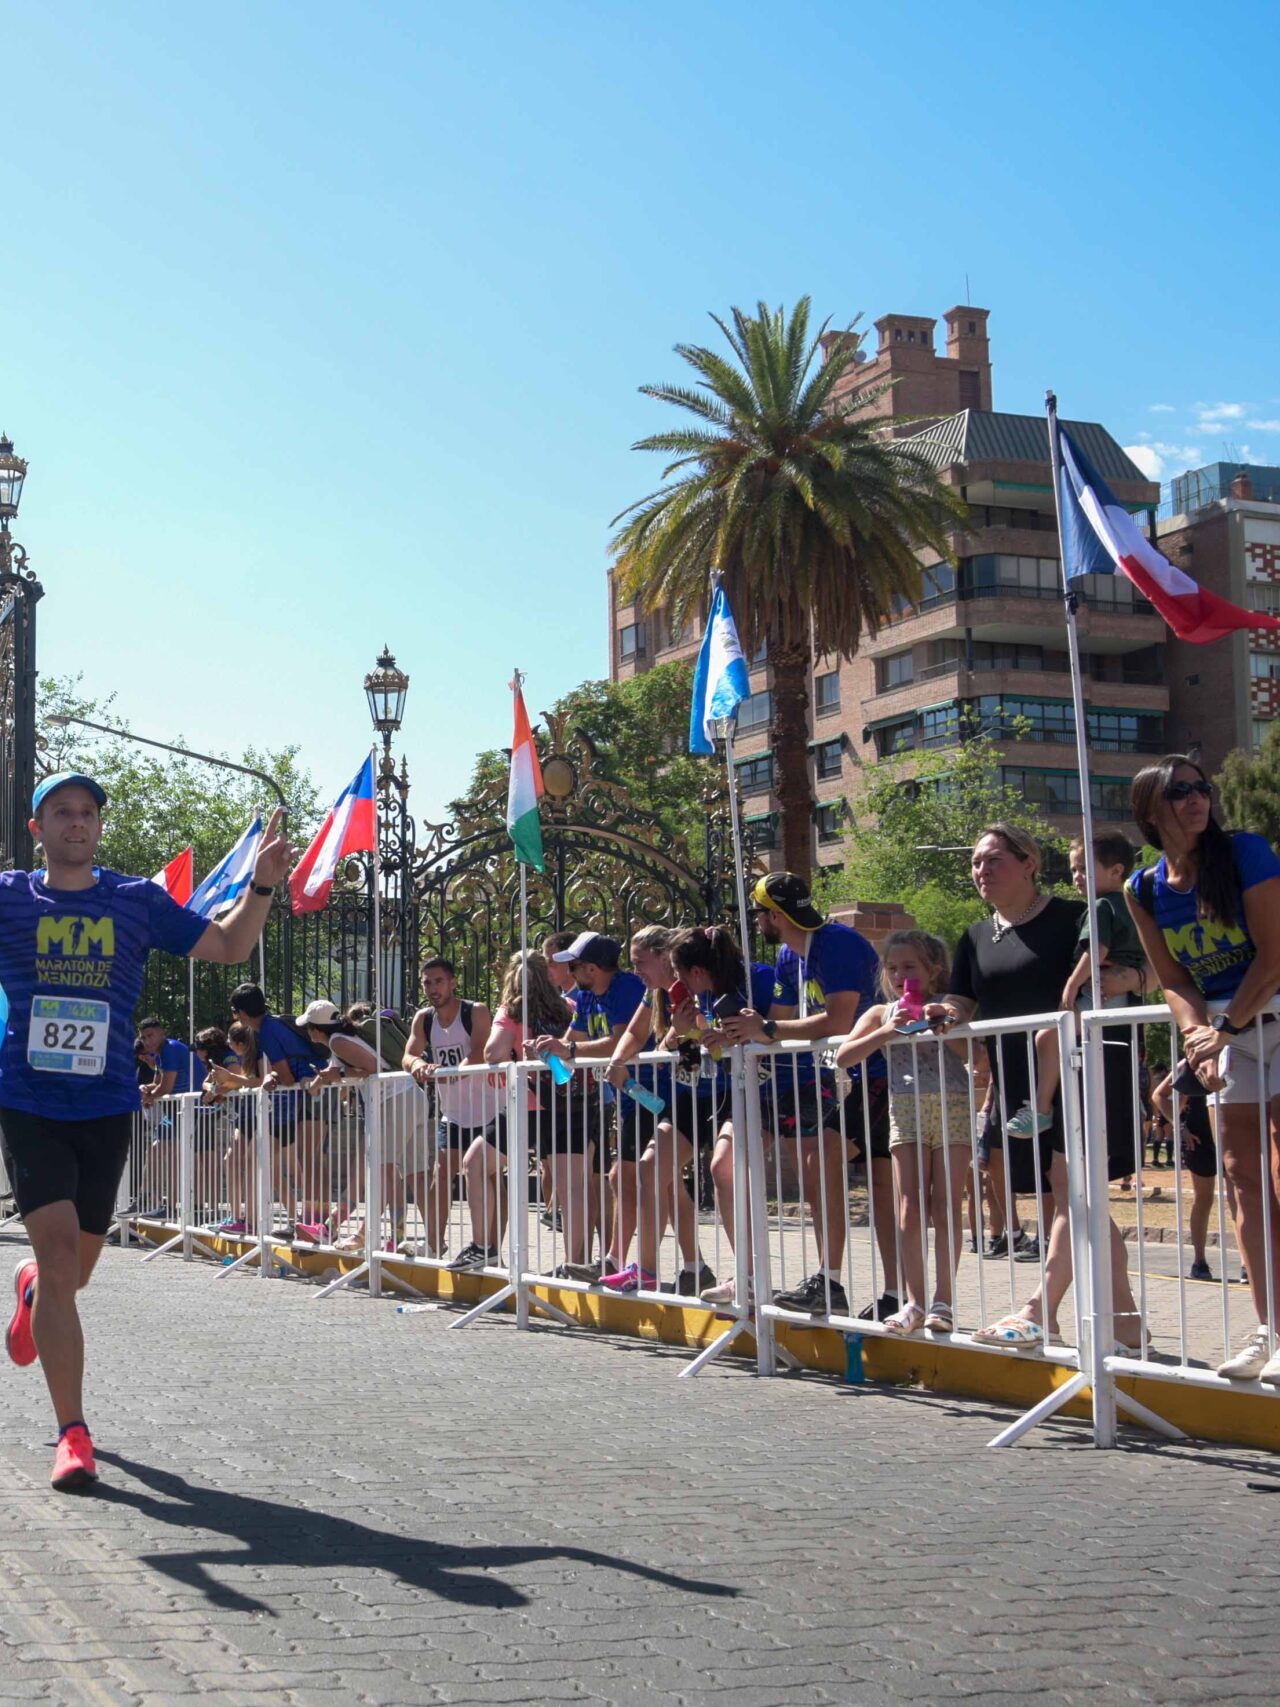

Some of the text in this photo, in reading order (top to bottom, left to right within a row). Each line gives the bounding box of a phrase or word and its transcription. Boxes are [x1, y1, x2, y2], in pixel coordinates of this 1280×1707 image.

[35, 957, 112, 972] MARATÓN DE
[38, 971, 111, 988] MENDOZA
[43, 1022, 96, 1052] 822
[439, 1047, 463, 1067] 261
